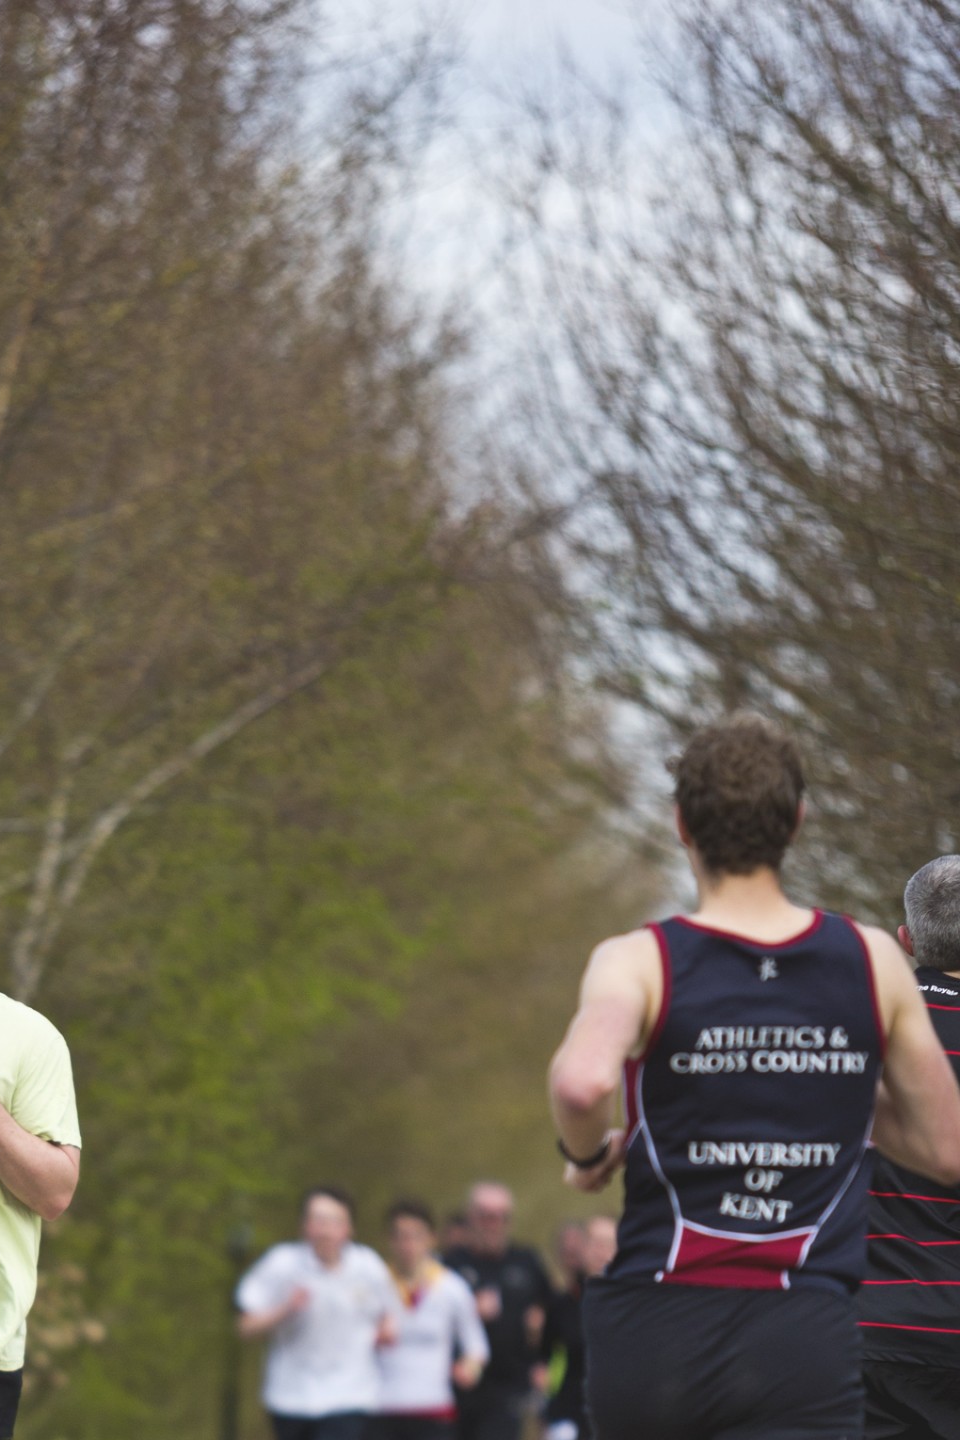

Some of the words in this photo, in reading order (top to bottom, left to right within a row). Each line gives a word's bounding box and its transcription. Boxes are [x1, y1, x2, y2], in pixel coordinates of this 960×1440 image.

[695, 1026, 825, 1050] ATHLETICS
[828, 1026, 849, 1049] &
[670, 1051, 748, 1074] CROSS
[751, 1050, 868, 1074] COUNTRY
[688, 1141, 840, 1167] UNIVERSITY
[744, 1167, 783, 1192] OF
[719, 1192, 793, 1223] KENT
